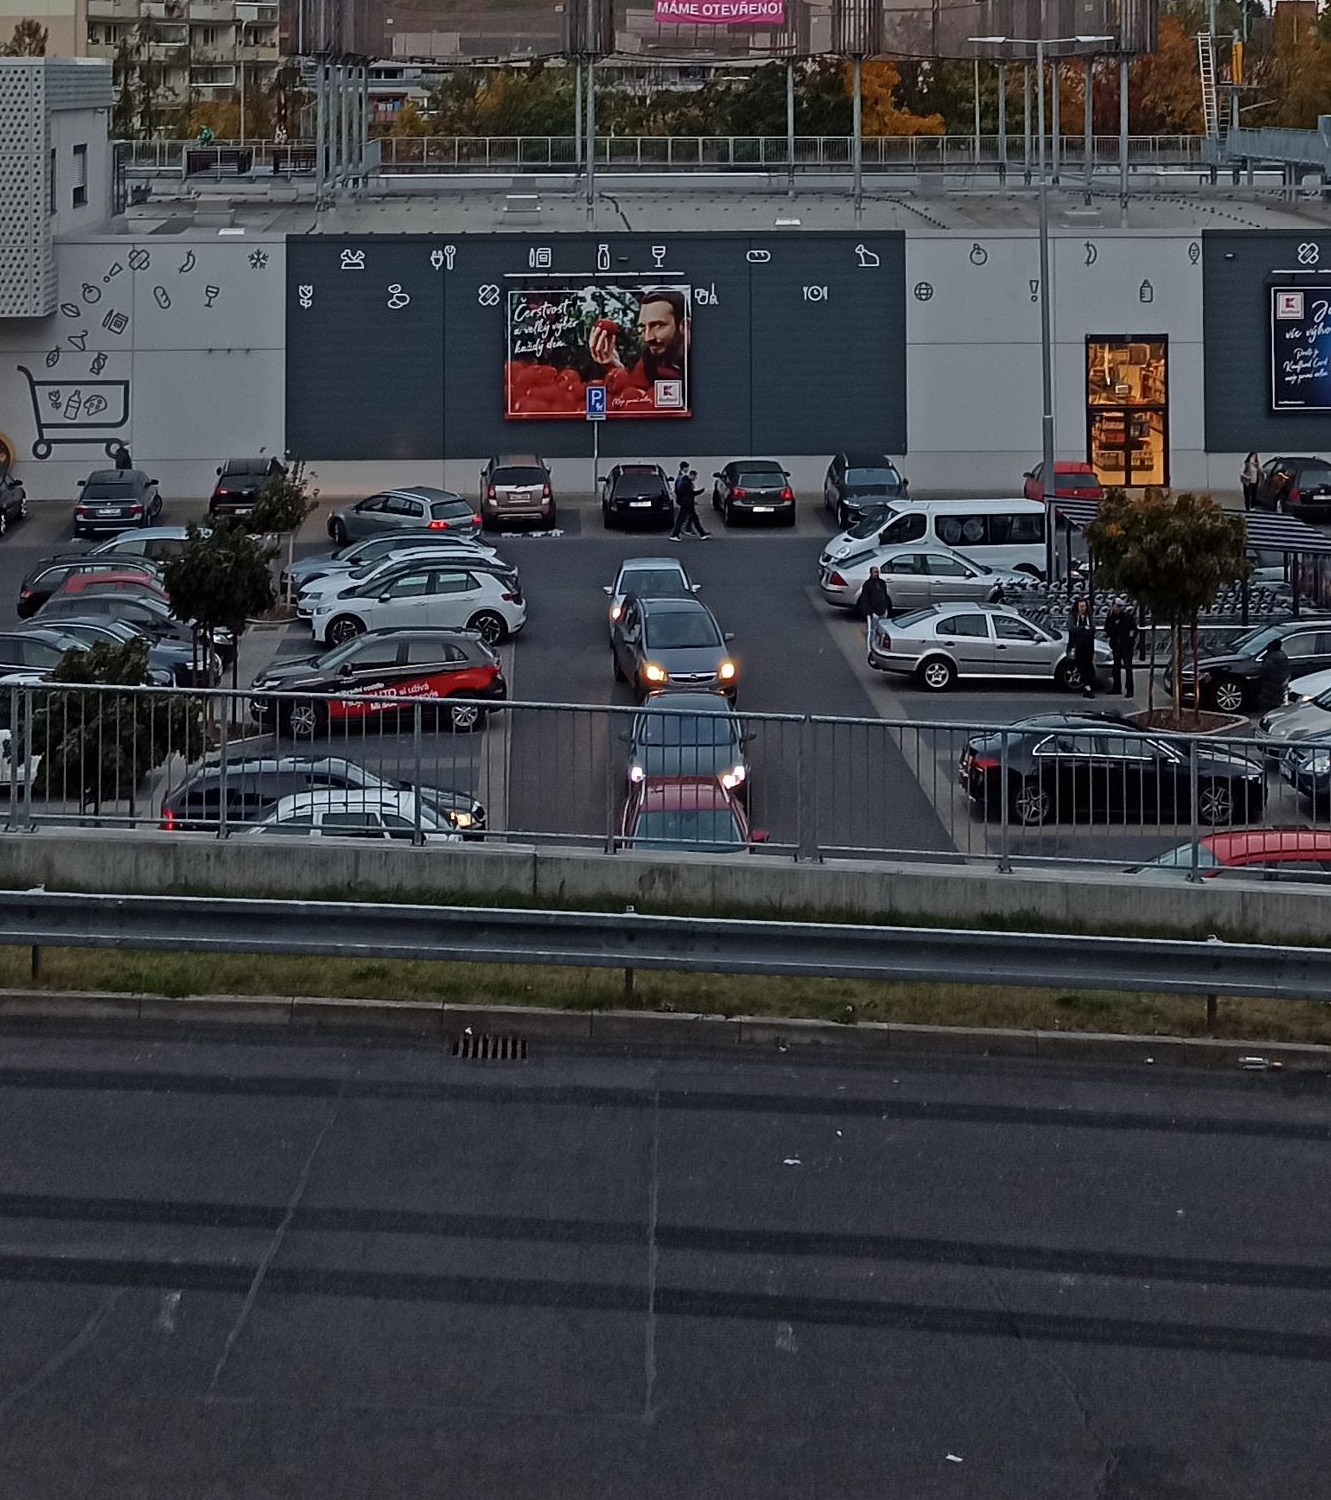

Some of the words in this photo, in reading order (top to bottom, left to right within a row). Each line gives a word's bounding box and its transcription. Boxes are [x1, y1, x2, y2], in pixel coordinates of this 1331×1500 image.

[657, 0, 699, 15] MÁME
[702, 1, 783, 16] OTEVŘENO!
[514, 297, 572, 322] Čerstvost
[525, 318, 550, 338] velký
[1285, 327, 1302, 339] víc
[591, 390, 602, 406] P
